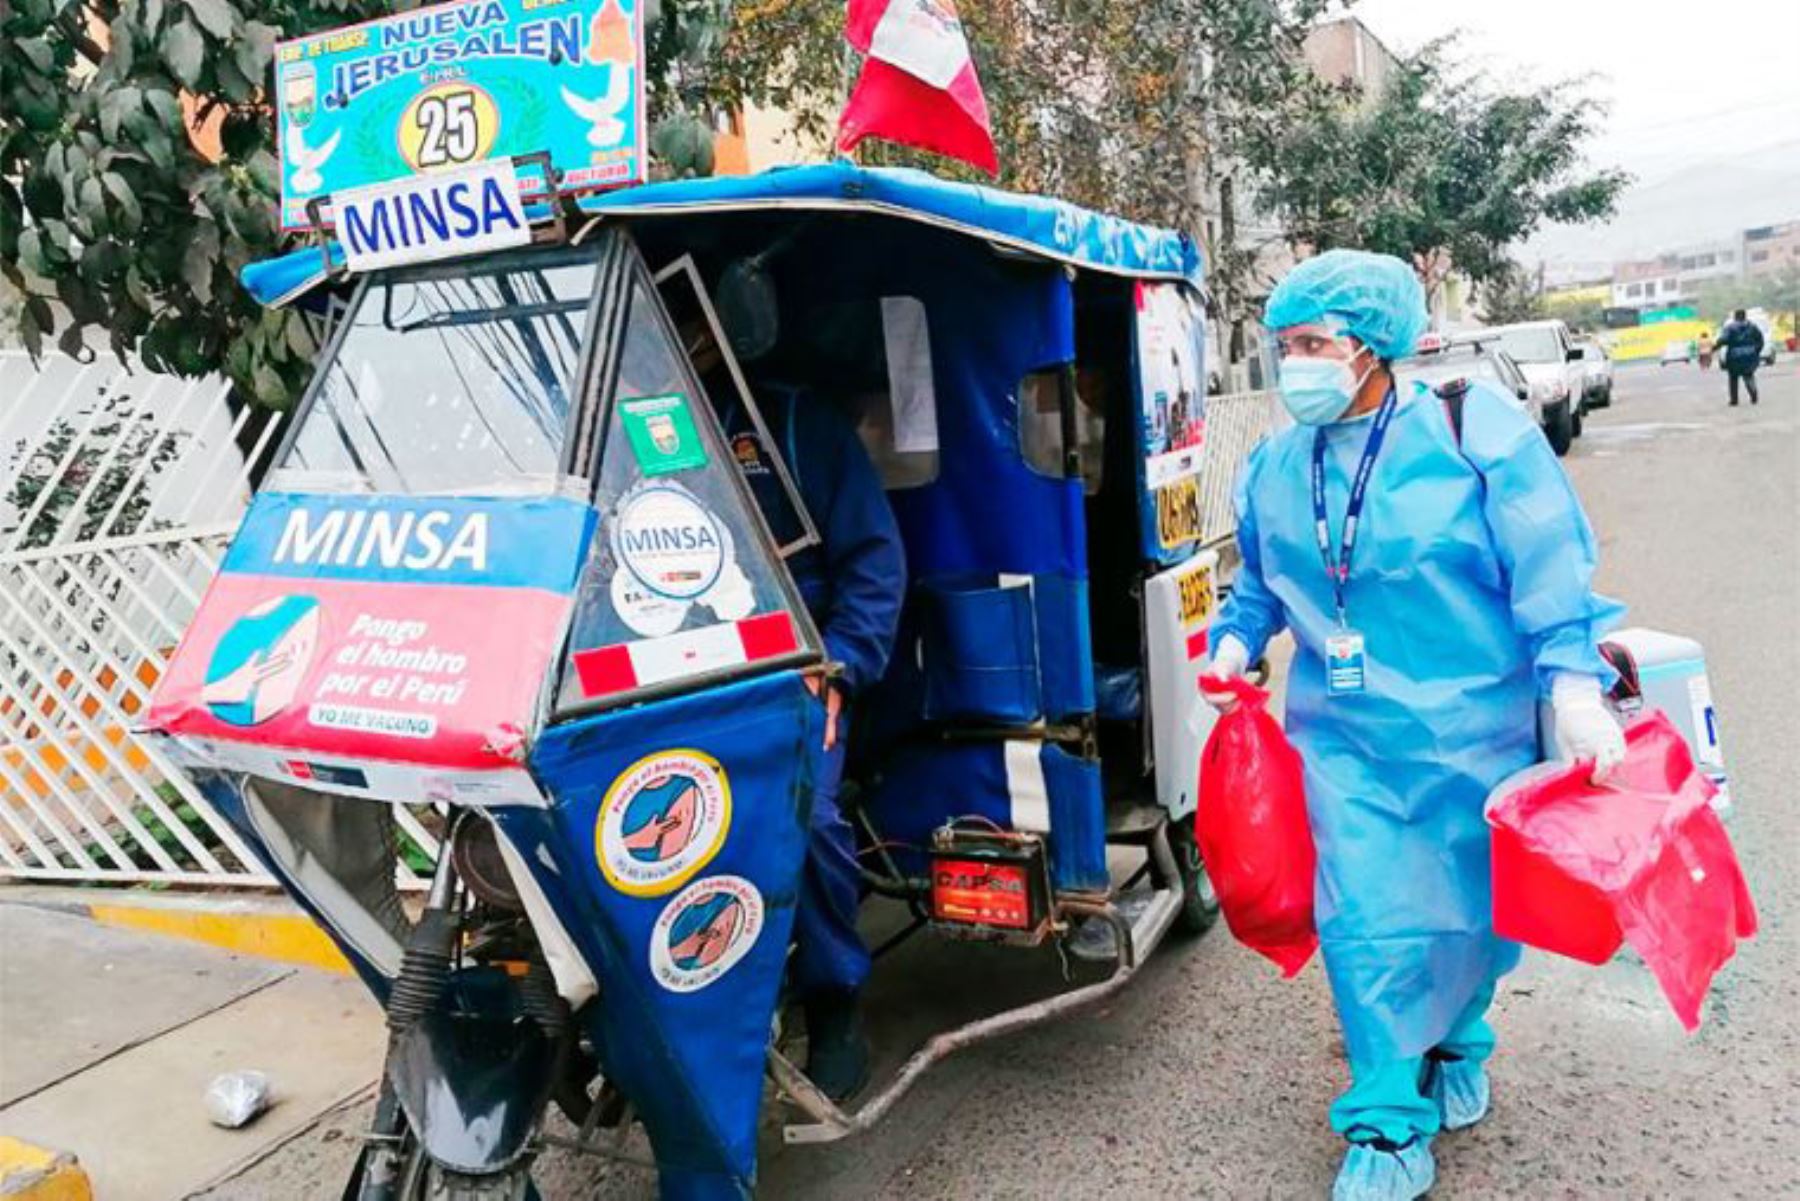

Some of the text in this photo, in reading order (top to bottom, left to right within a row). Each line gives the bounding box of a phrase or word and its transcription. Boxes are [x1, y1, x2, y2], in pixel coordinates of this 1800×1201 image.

[383, 1, 506, 46] NUEVA
[325, 16, 581, 107] JERUSALEN
[417, 89, 478, 168] 25
[344, 177, 520, 255] MINSA
[273, 509, 489, 571] MINSA
[624, 526, 716, 552] MINSA
[349, 614, 427, 646] Pongo
[336, 641, 467, 674] el hombro
[315, 672, 469, 704] por el Perú
[317, 709, 430, 734] YO ME VACUNO
